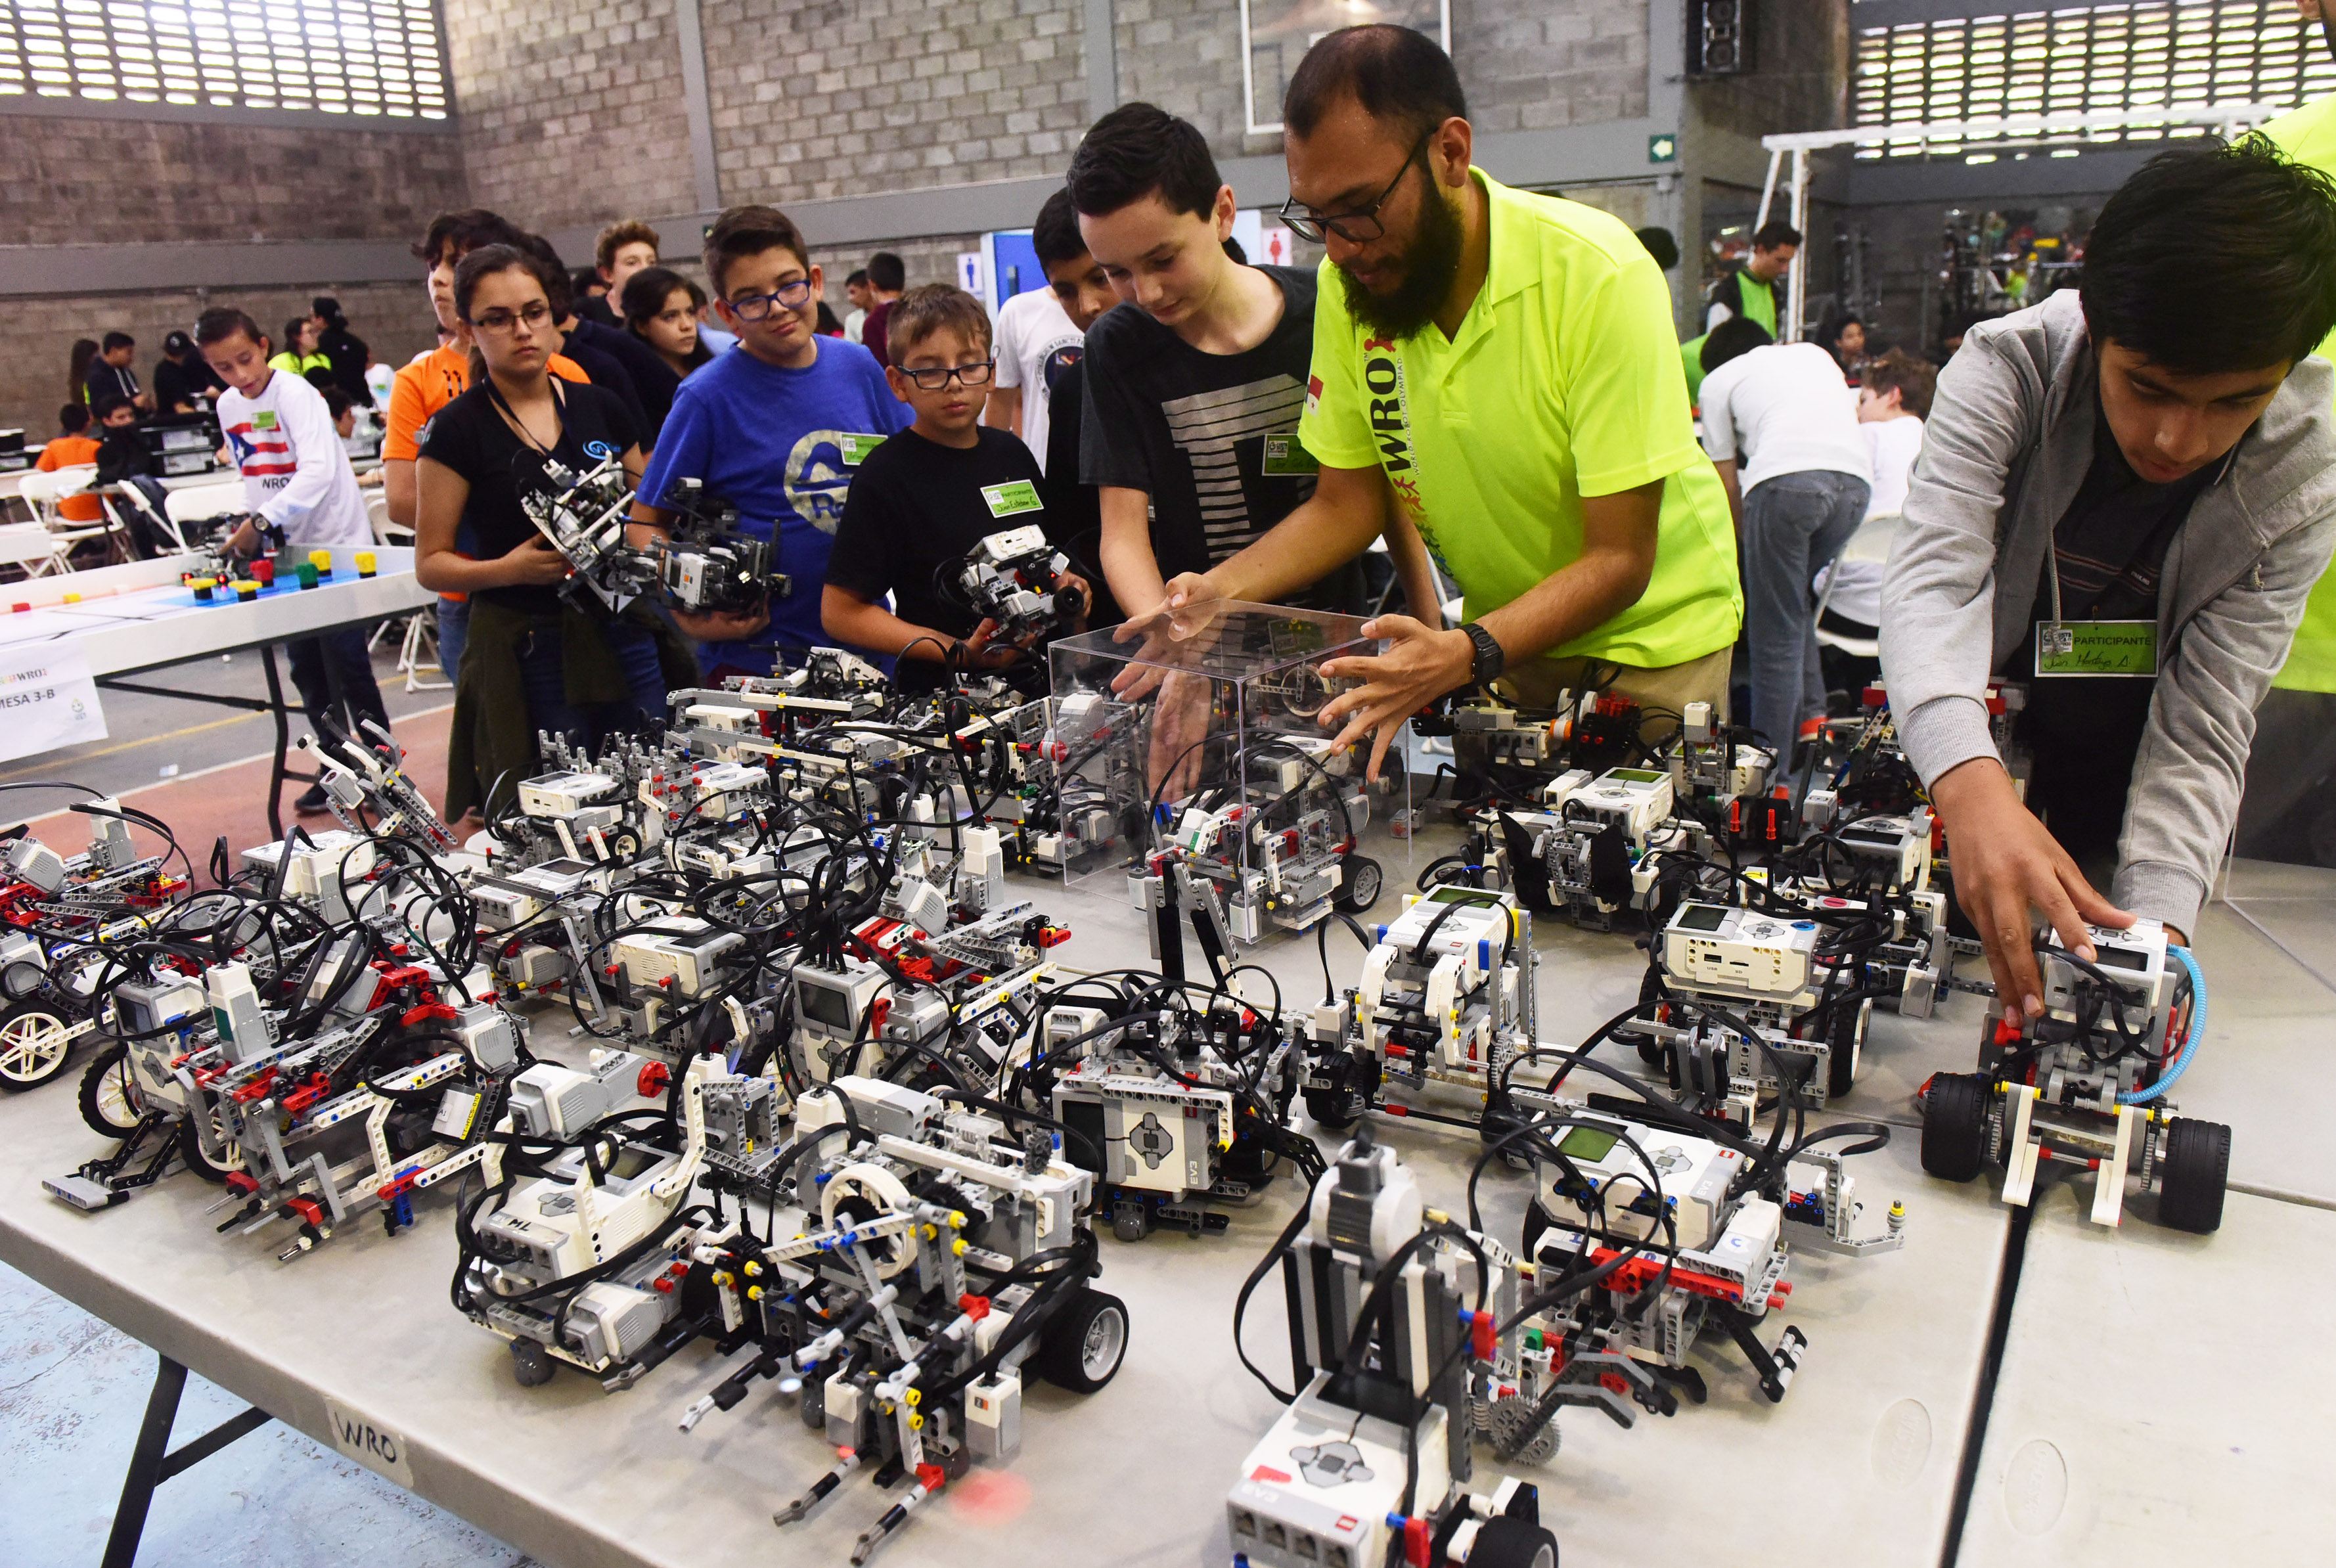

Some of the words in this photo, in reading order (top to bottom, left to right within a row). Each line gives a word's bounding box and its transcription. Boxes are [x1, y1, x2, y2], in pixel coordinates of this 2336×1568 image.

[1397, 358, 1406, 406] OLYMPIAD
[1365, 357, 1412, 472] WRO
[1402, 411, 1413, 442] ROBOT
[1408, 446, 1420, 476] WORLD
[261, 477, 290, 489] WRO
[2074, 637, 2153, 646] PARTICIPANTE
[16, 668, 43, 681] WRO
[34, 688, 55, 702] 3-B
[1795, 939, 1805, 949] EV3
[146, 1094, 158, 1104] EV3
[1189, 1160, 1198, 1185] EV3
[1696, 1180, 1713, 1196] EV3
[506, 1219, 532, 1232] ML
[1730, 1238, 1743, 1247] C
[334, 1411, 397, 1463] WRO
[1241, 1483, 1280, 1504] EV3
